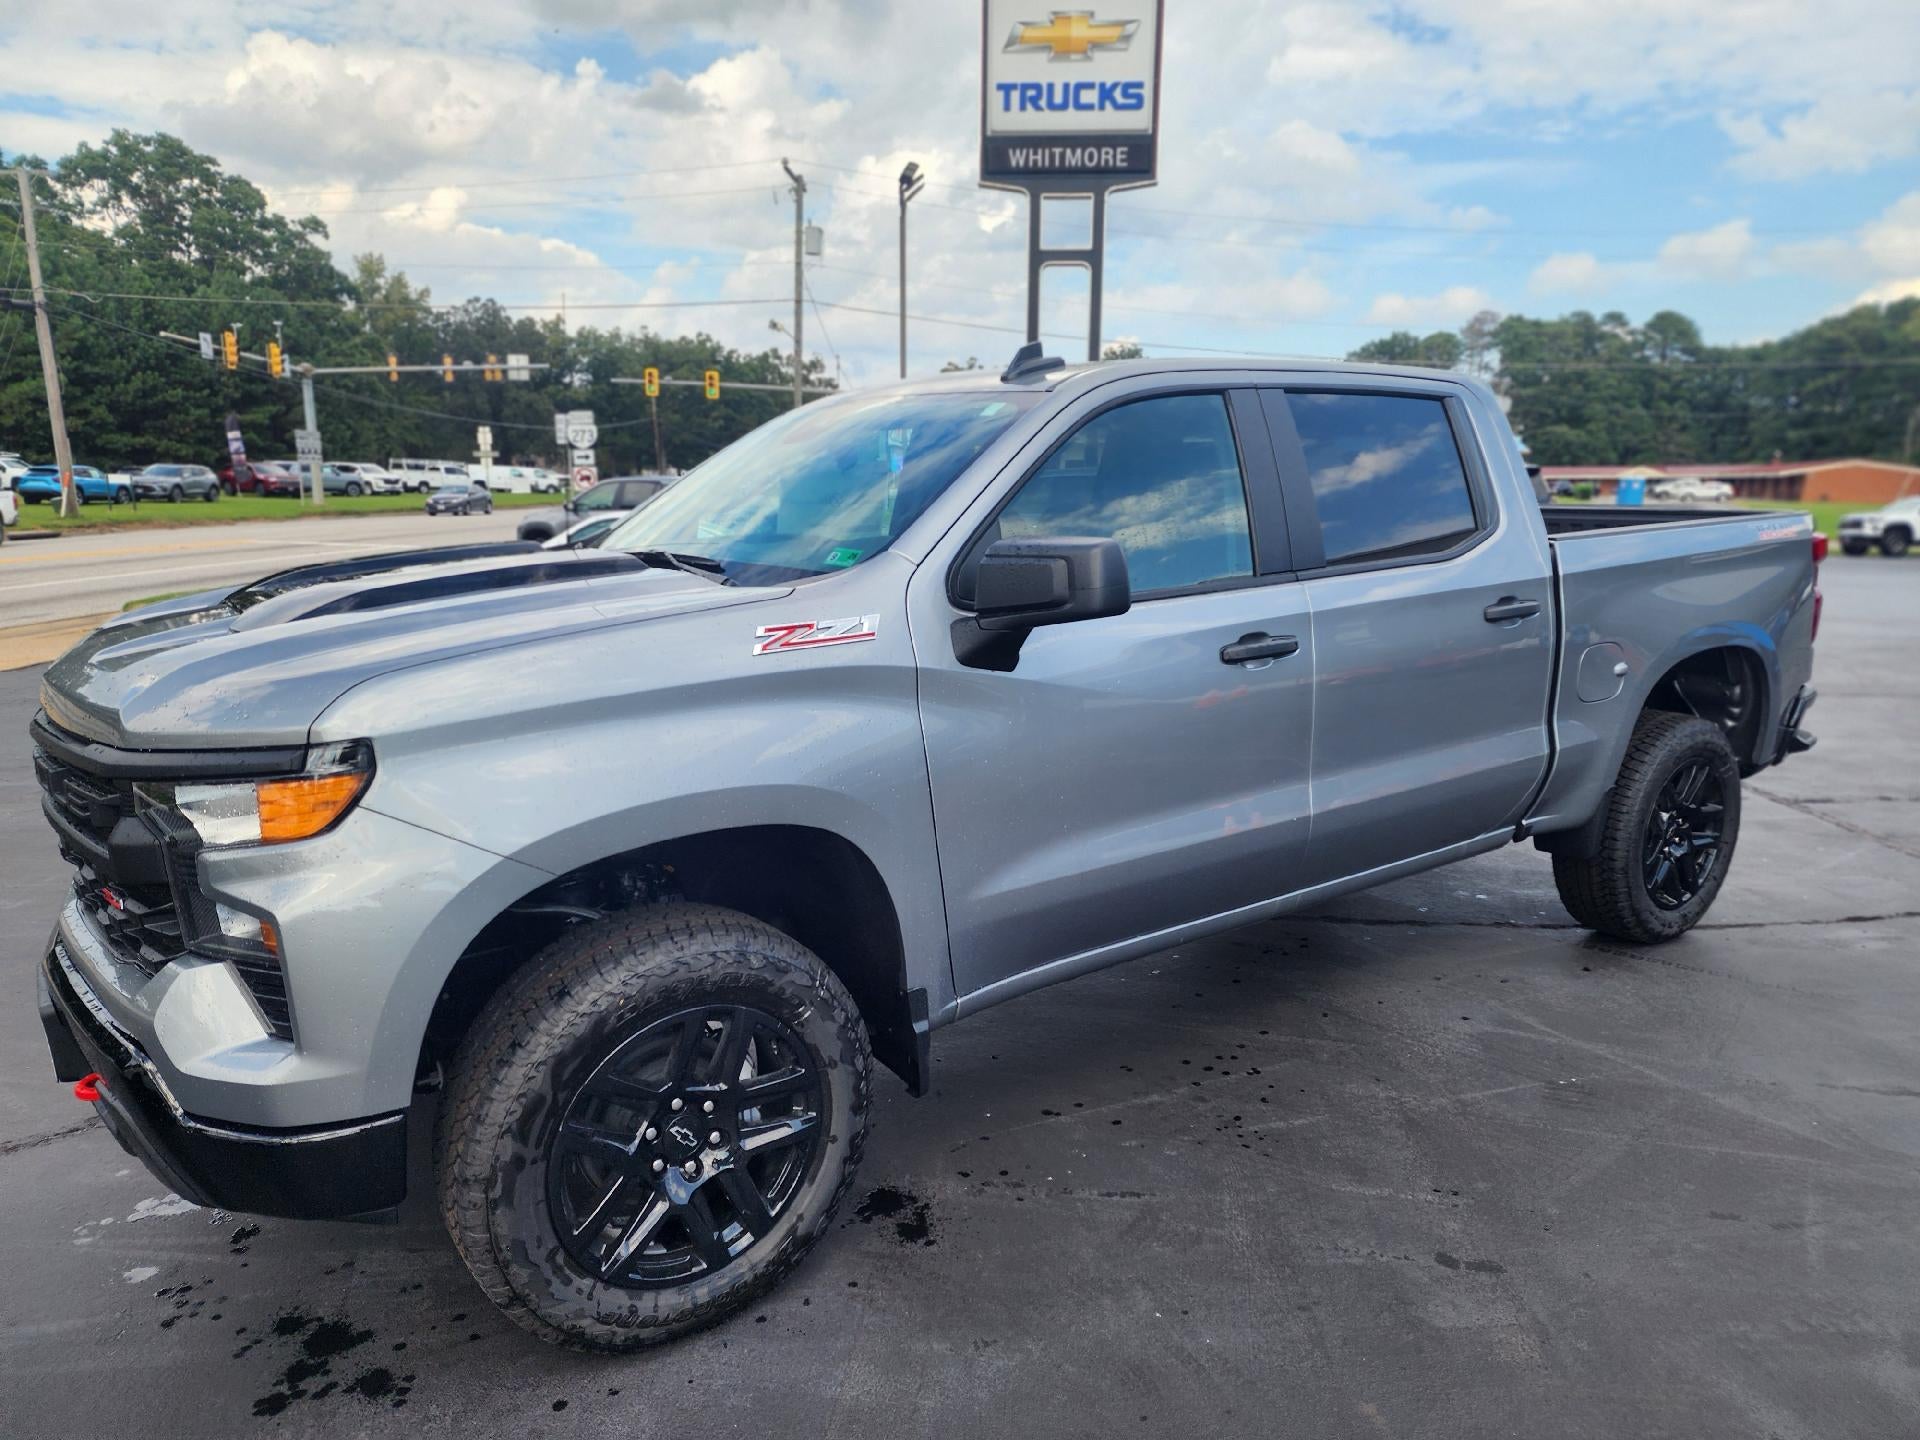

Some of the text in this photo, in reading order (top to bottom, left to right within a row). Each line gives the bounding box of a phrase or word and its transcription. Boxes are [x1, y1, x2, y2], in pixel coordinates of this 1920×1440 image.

[995, 81, 1145, 112] TRUCKS
[1008, 147, 1128, 168] WHITMORE
[571, 429, 595, 443] 273
[752, 613, 881, 656] Z71
